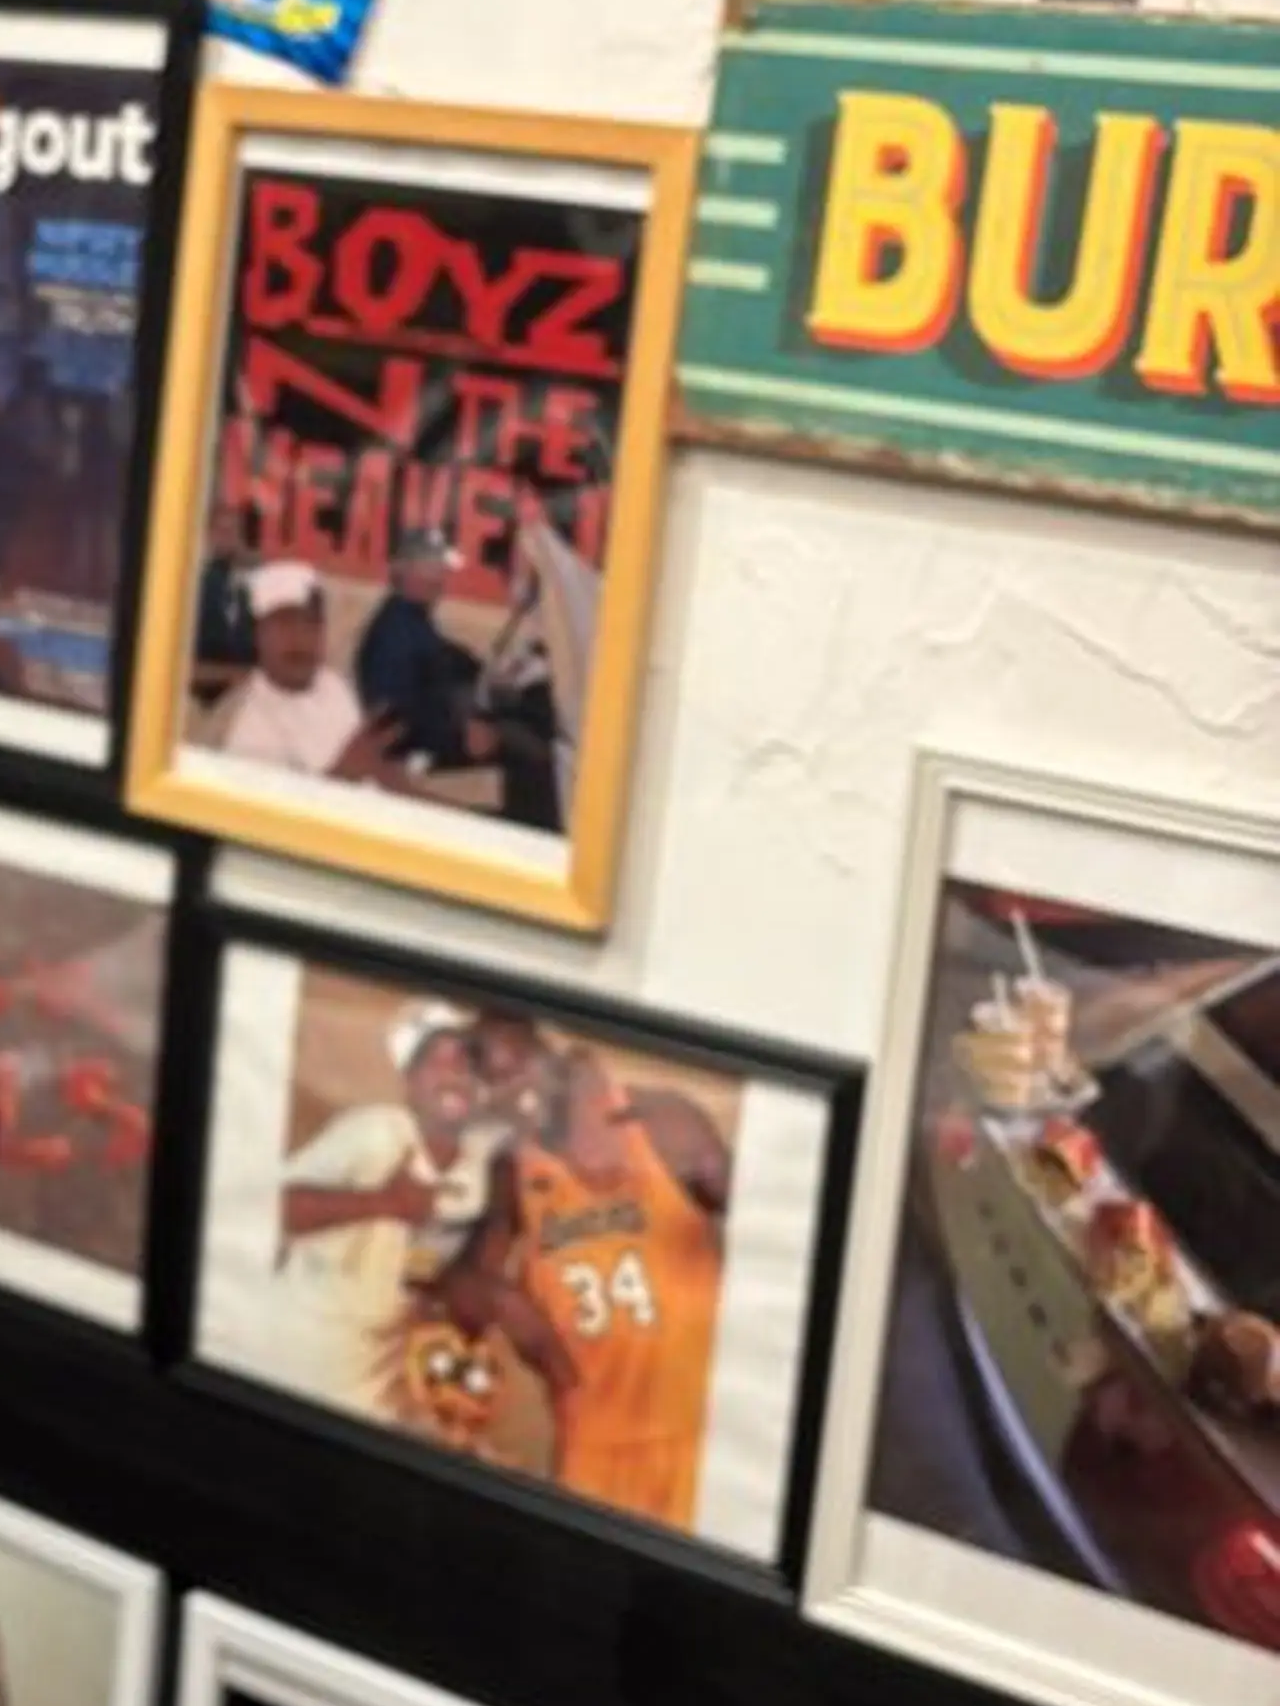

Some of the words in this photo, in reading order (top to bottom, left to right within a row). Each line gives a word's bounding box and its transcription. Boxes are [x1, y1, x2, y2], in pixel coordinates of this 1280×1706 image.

[243, 182, 622, 371] BOYZ
[806, 91, 1280, 401] BUR
[454, 374, 599, 483] THE
[563, 1250, 654, 1337] 34
